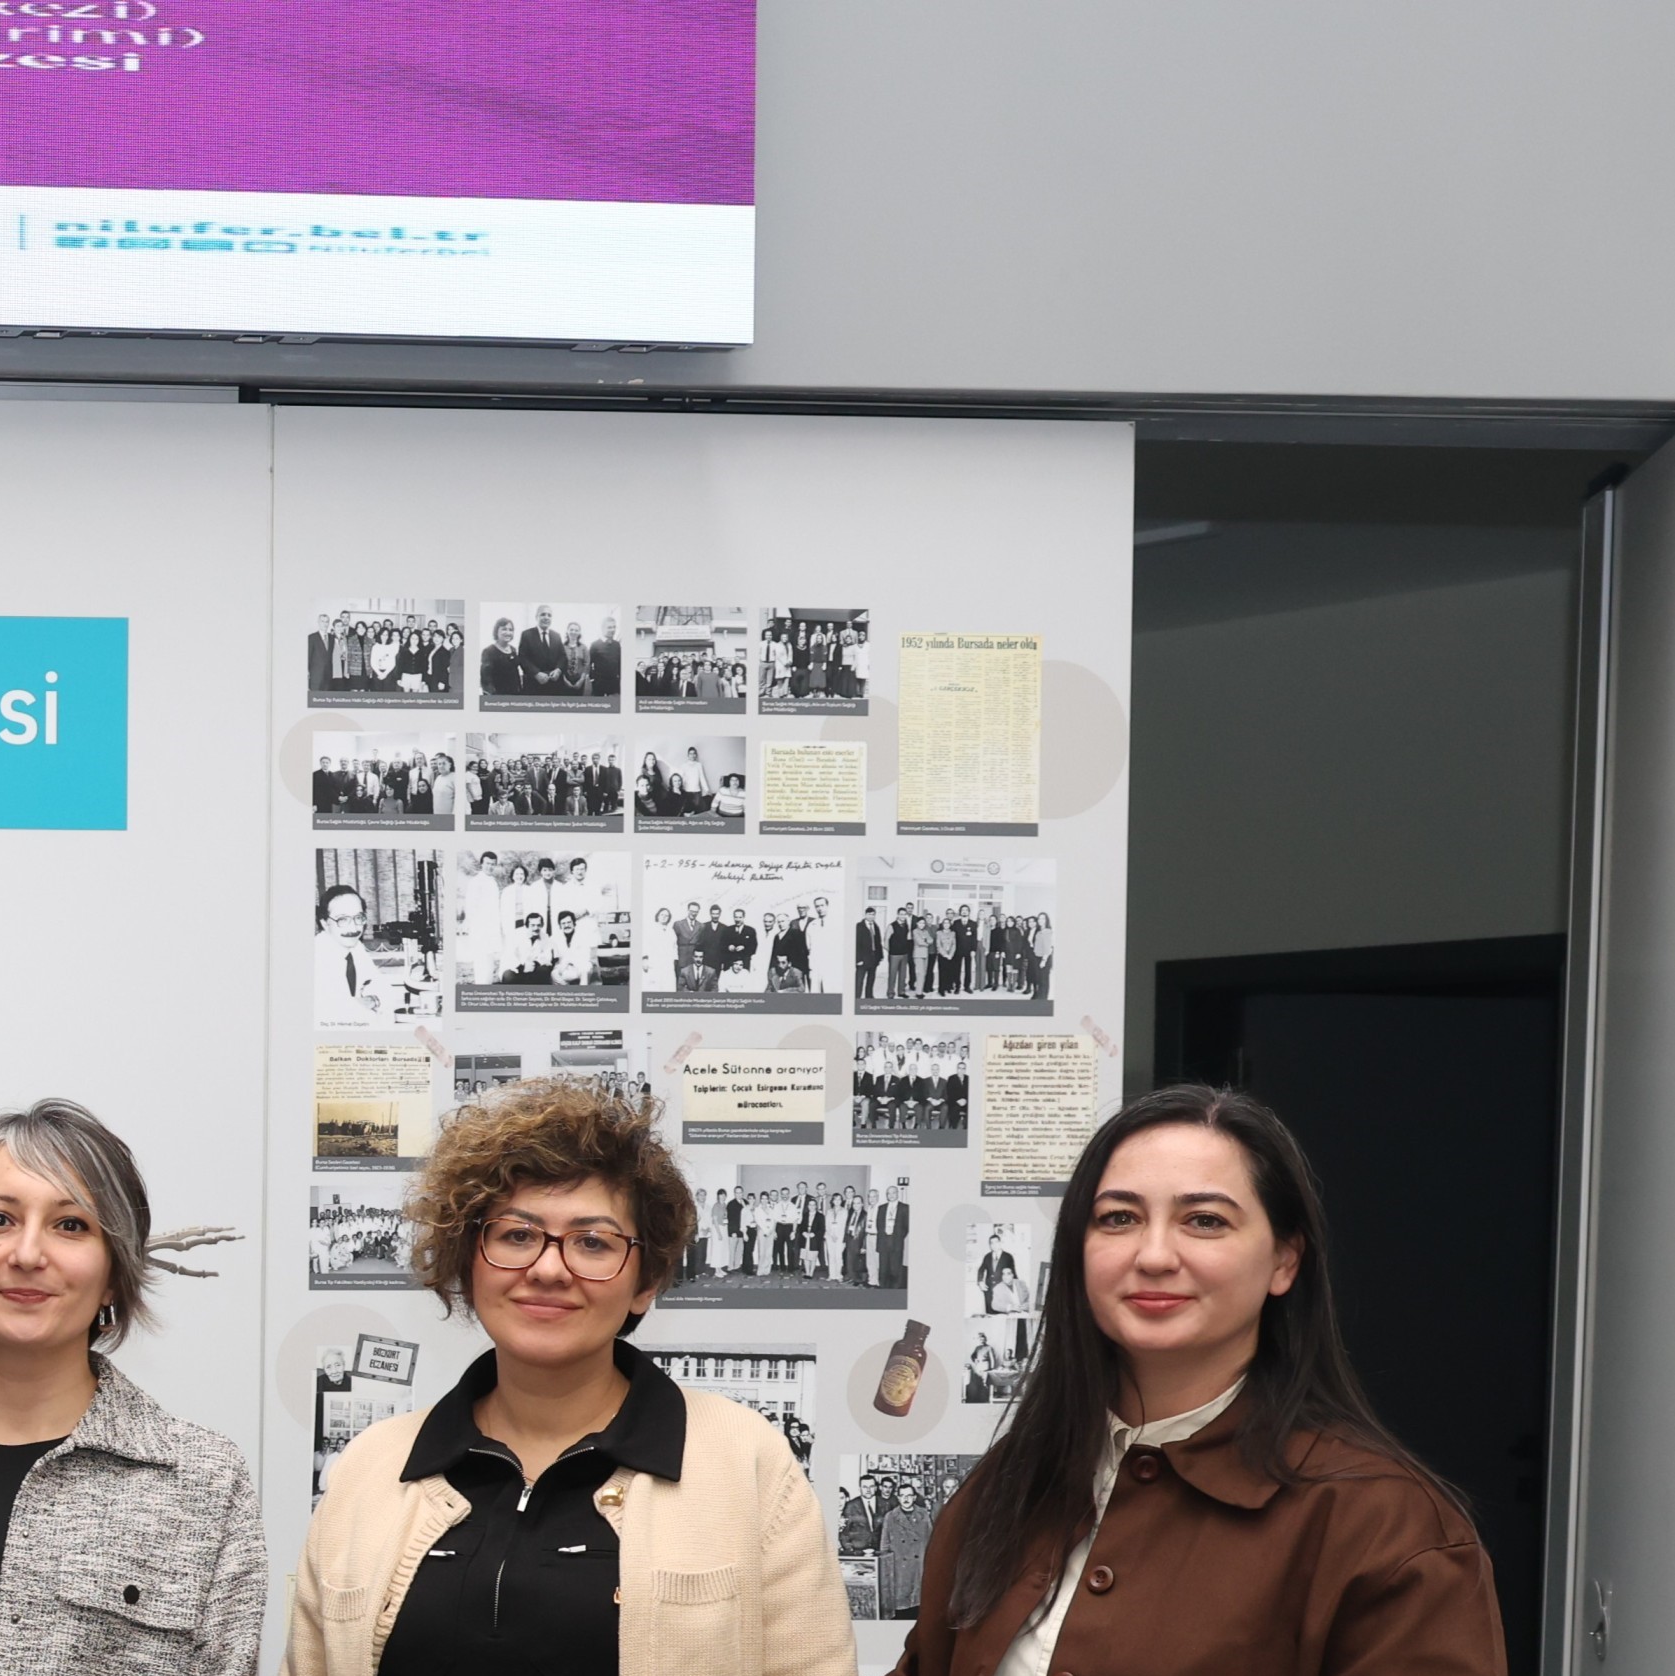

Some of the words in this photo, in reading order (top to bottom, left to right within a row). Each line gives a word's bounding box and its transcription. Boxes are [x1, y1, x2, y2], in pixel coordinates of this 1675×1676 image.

[54, 219, 489, 242] nilufer.bel.tr
[900, 636, 923, 649] 1952
[925, 637, 955, 651] yılında
[957, 636, 995, 649] Bursada
[996, 638, 1018, 650] neler
[683, 1063, 718, 1076] Acele
[731, 1083, 753, 1094] Çocuk
[757, 1083, 788, 1093] Esirgeme
